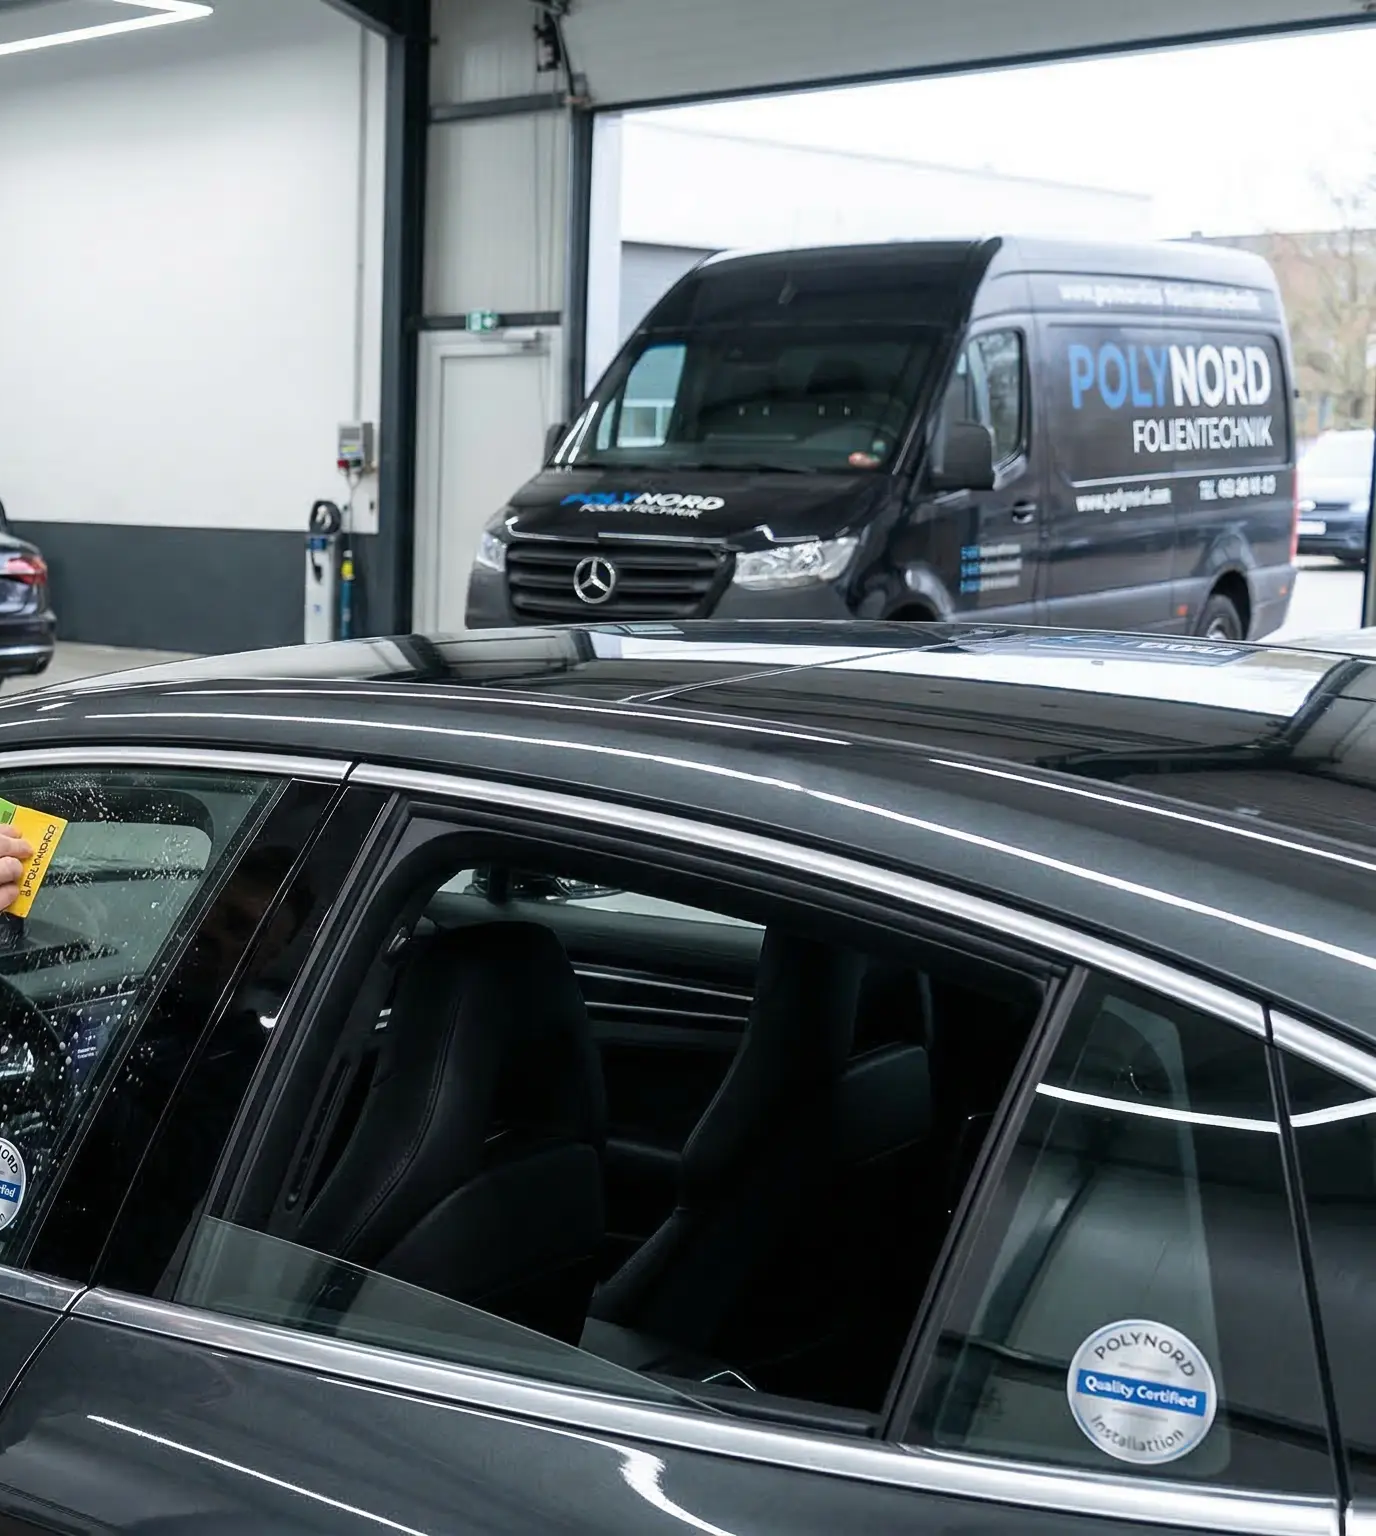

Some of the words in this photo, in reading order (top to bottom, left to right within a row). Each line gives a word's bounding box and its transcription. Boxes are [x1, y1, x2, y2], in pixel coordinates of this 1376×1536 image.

[1068, 341, 1272, 410] POLYNORD
[1132, 416, 1274, 453] FOLIENTECHNIK
[1094, 1332, 1196, 1377] POLYNORD
[1085, 1375, 1135, 1399] Quality
[1136, 1386, 1197, 1409] Certified
